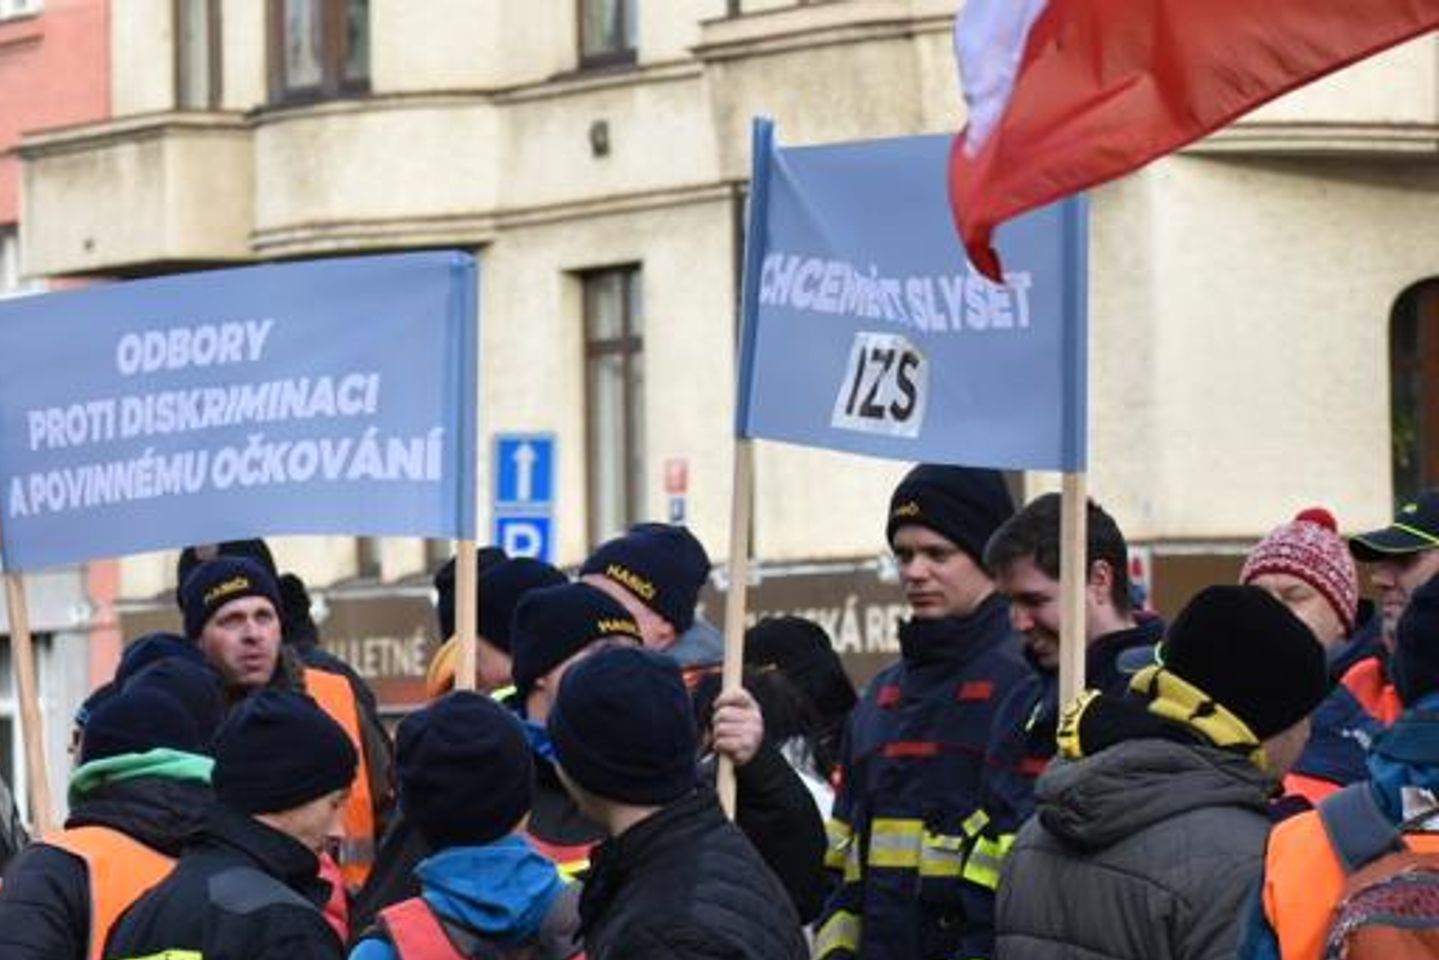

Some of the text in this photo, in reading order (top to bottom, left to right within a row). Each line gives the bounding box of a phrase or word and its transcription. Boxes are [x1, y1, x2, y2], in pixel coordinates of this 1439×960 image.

[116, 319, 275, 376] ODBORY
[845, 347, 919, 423] IZS
[27, 374, 381, 452] PROTI DISKRIMINACI
[9, 427, 443, 518] A POVINNÉMU OČKOVÁNÍ
